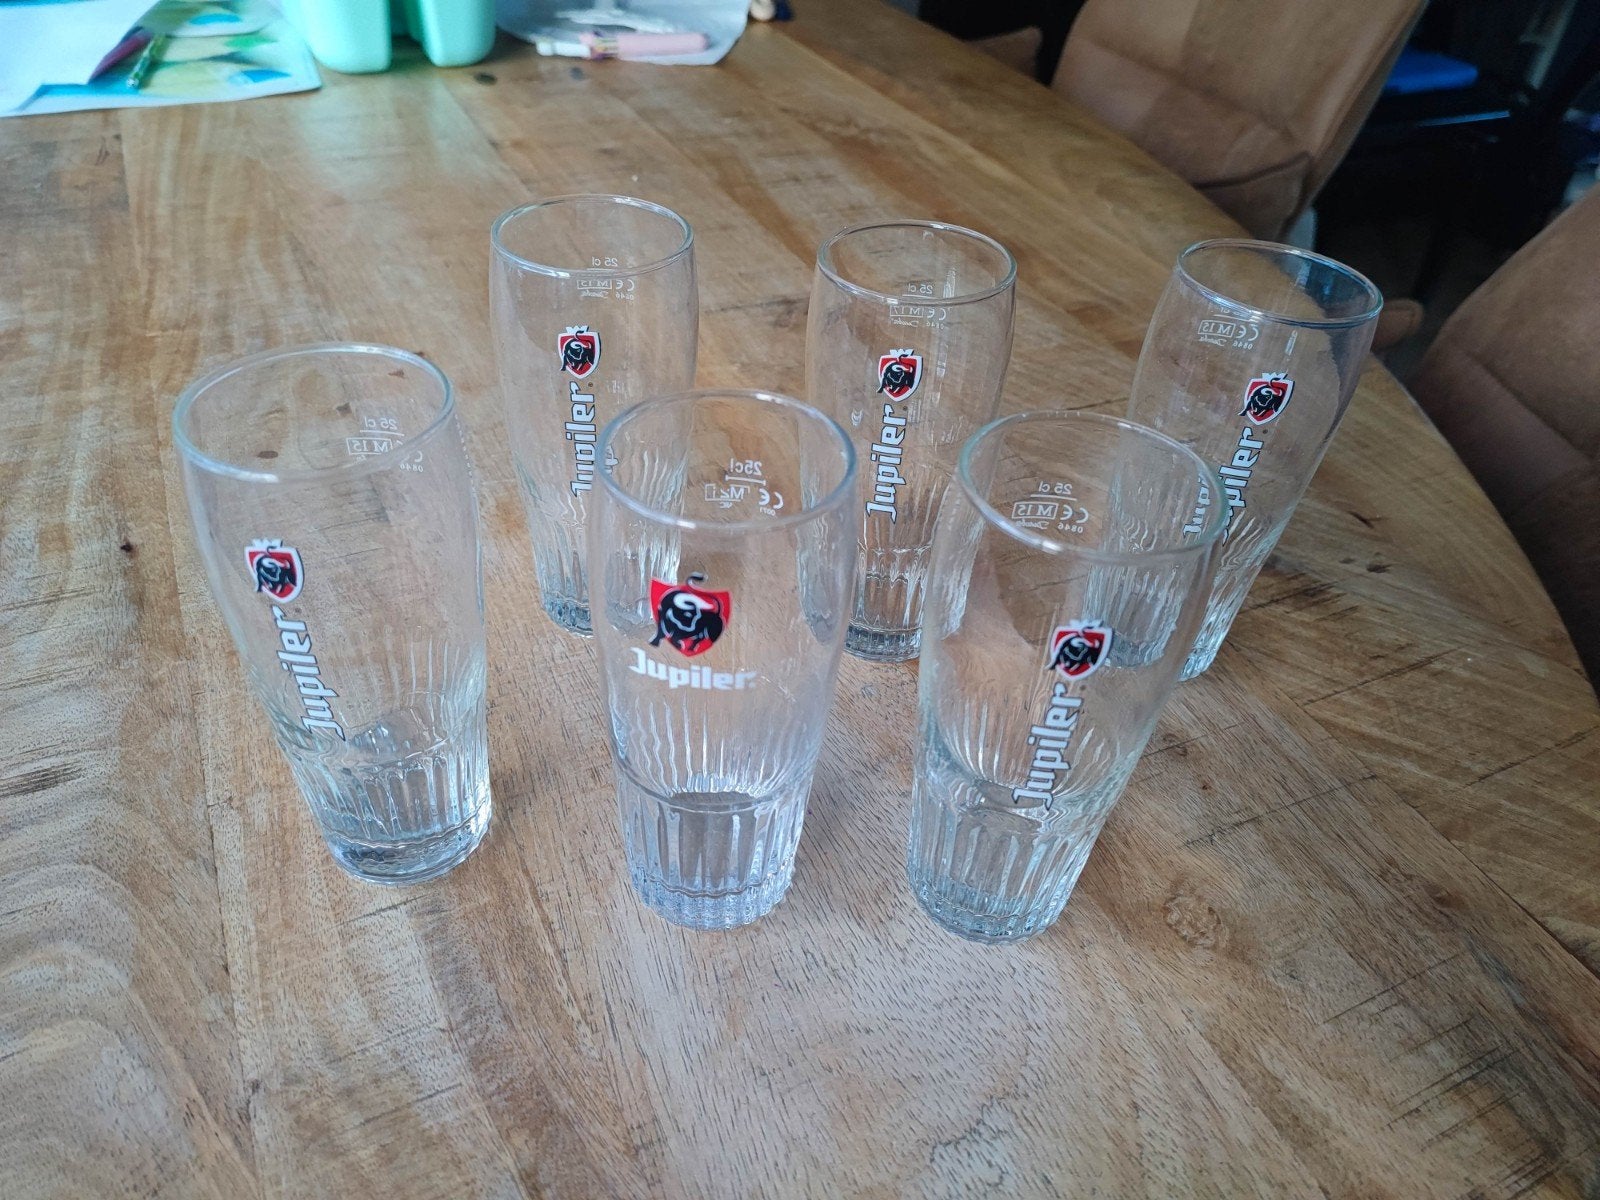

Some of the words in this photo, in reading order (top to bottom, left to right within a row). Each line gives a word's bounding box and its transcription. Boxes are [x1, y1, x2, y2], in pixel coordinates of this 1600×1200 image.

[866, 403, 907, 524] Jupiler
[271, 603, 346, 741] Jupiler
[627, 646, 757, 690] Jupiler
[1012, 682, 1084, 811] Jupiler
